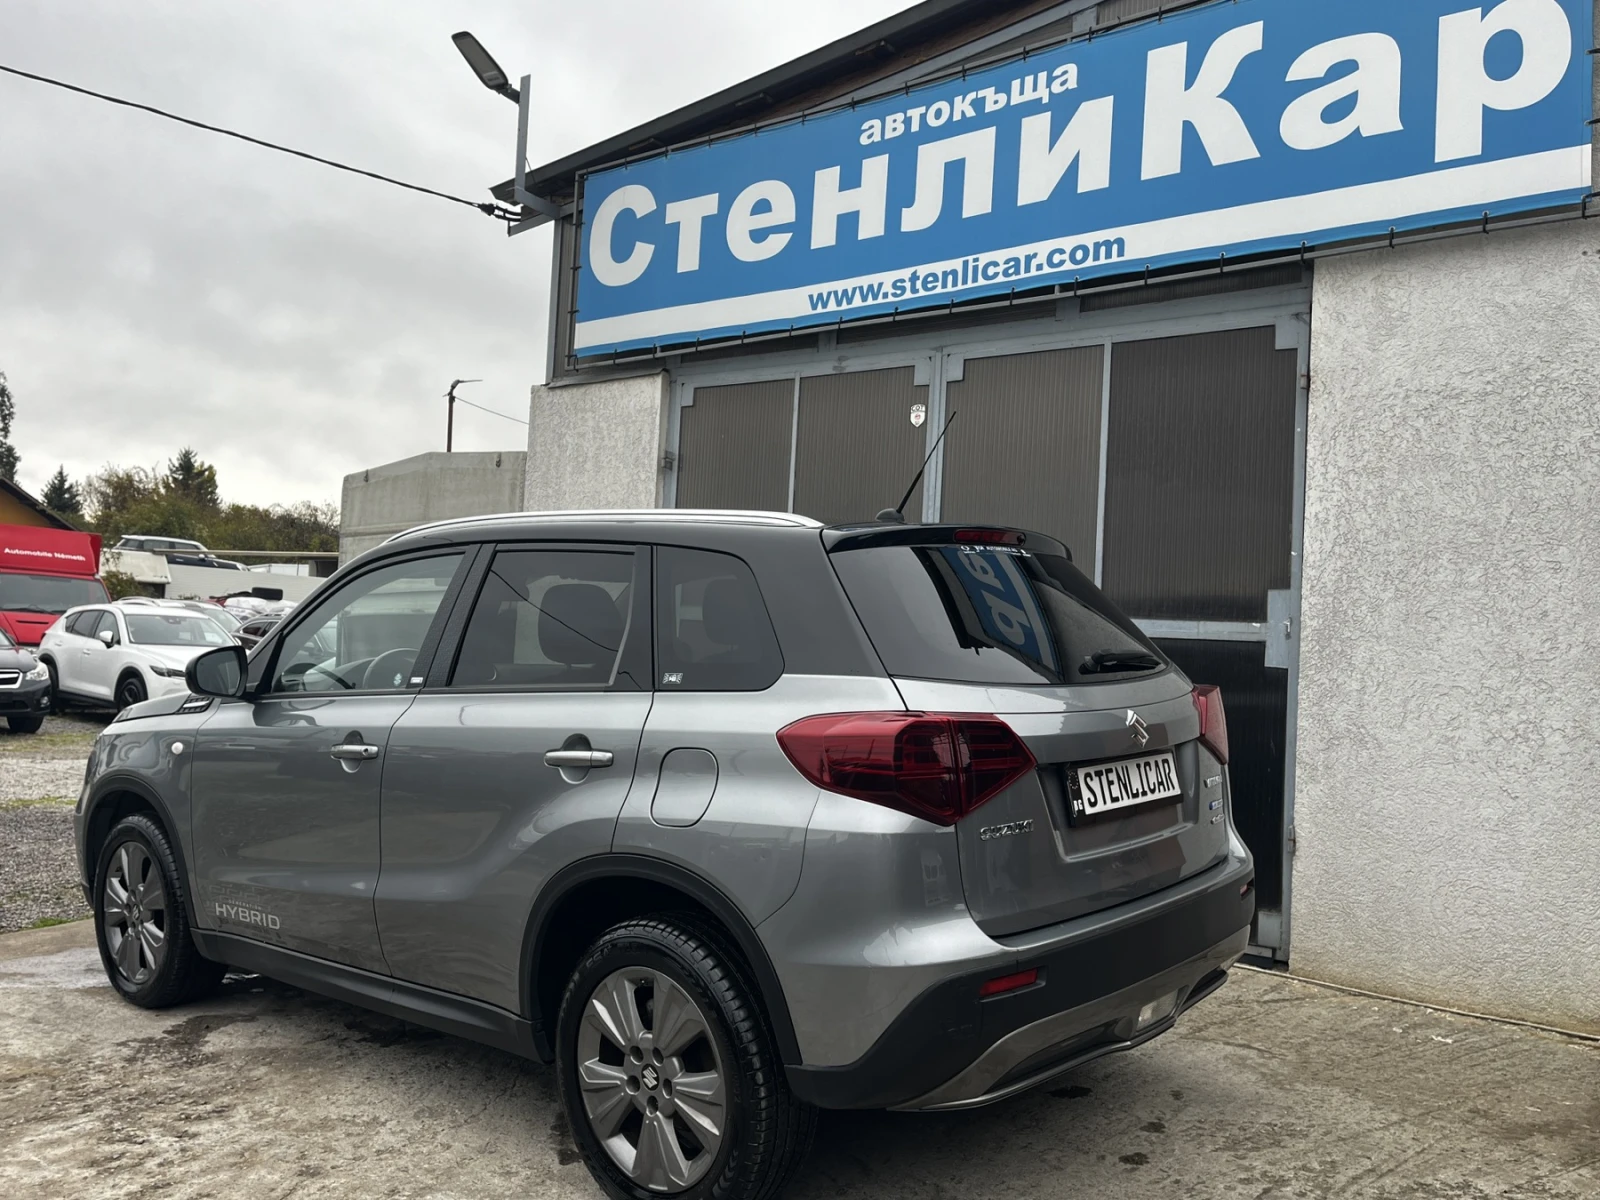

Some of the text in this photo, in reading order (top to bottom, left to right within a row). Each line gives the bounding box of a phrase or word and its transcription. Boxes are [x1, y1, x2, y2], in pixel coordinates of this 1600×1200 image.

[860, 63, 1078, 146] автокъща
[808, 237, 1125, 312] www.stenlicar.com
[4, 547, 53, 558] Automobile
[1083, 758, 1176, 808] STENLICAR
[980, 819, 1034, 841] SUZUKI
[215, 902, 281, 931] HYBRID
